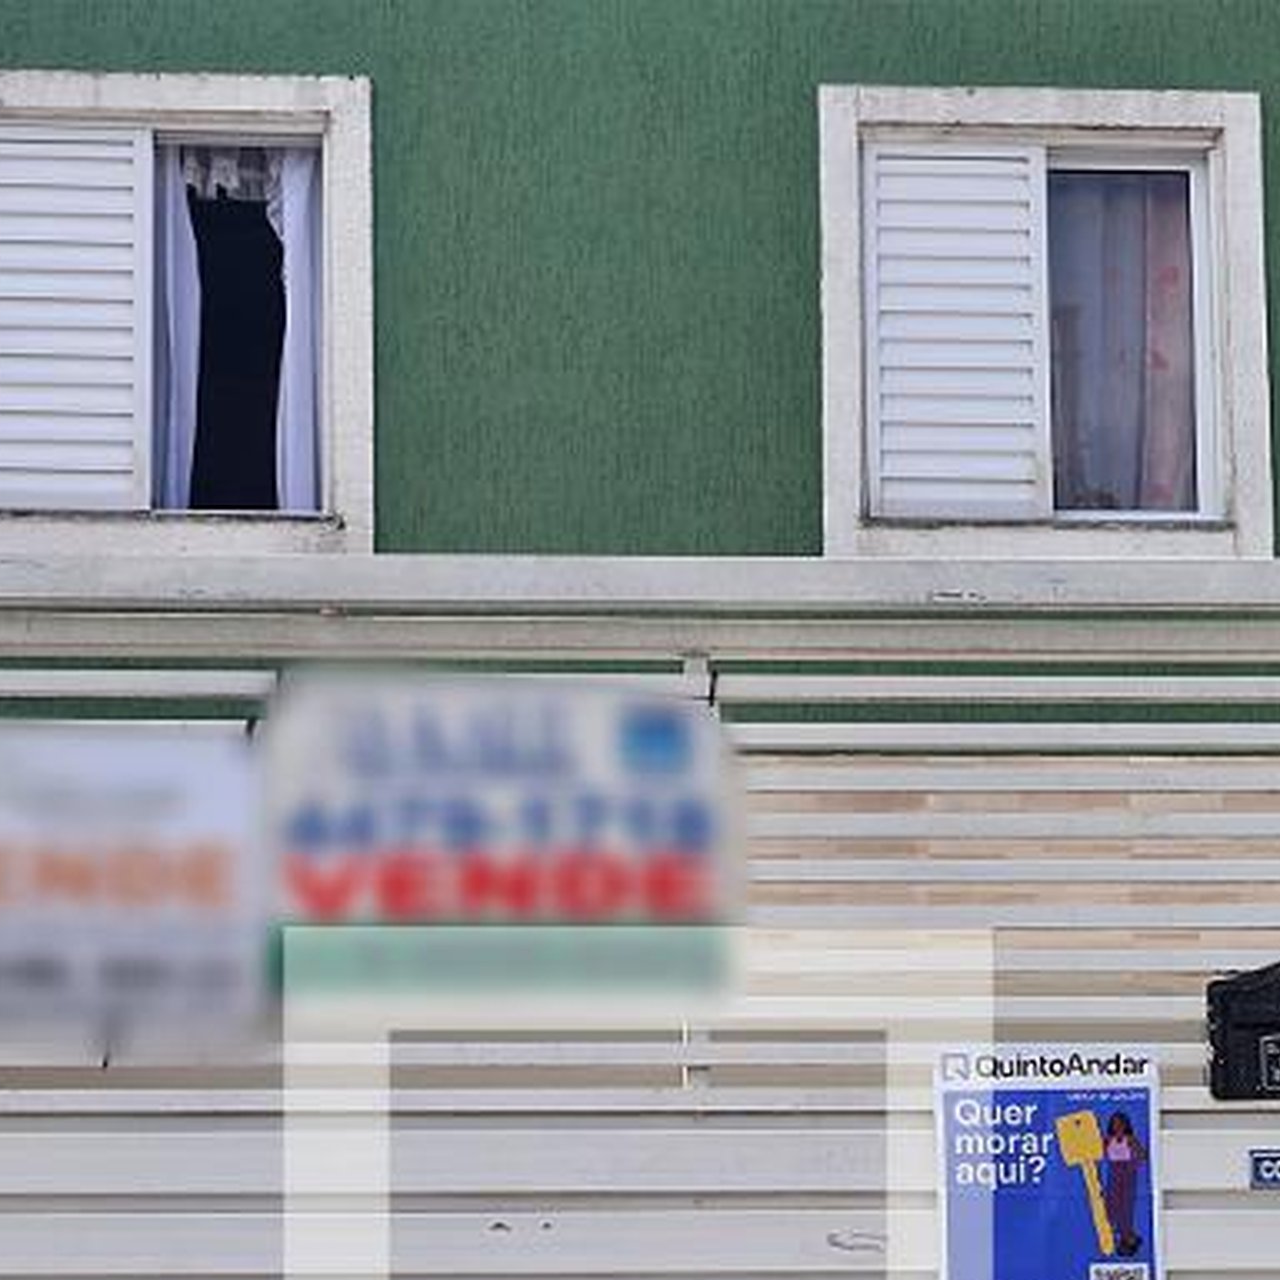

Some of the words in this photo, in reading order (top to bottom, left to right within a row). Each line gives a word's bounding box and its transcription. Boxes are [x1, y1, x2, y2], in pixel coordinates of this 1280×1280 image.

[279, 853, 717, 921] VENDE
[976, 1053, 1148, 1080] QuintoAndar
[955, 1099, 1038, 1126] Quer
[955, 1132, 1053, 1155] morar
[955, 1156, 1046, 1190] aqui?
